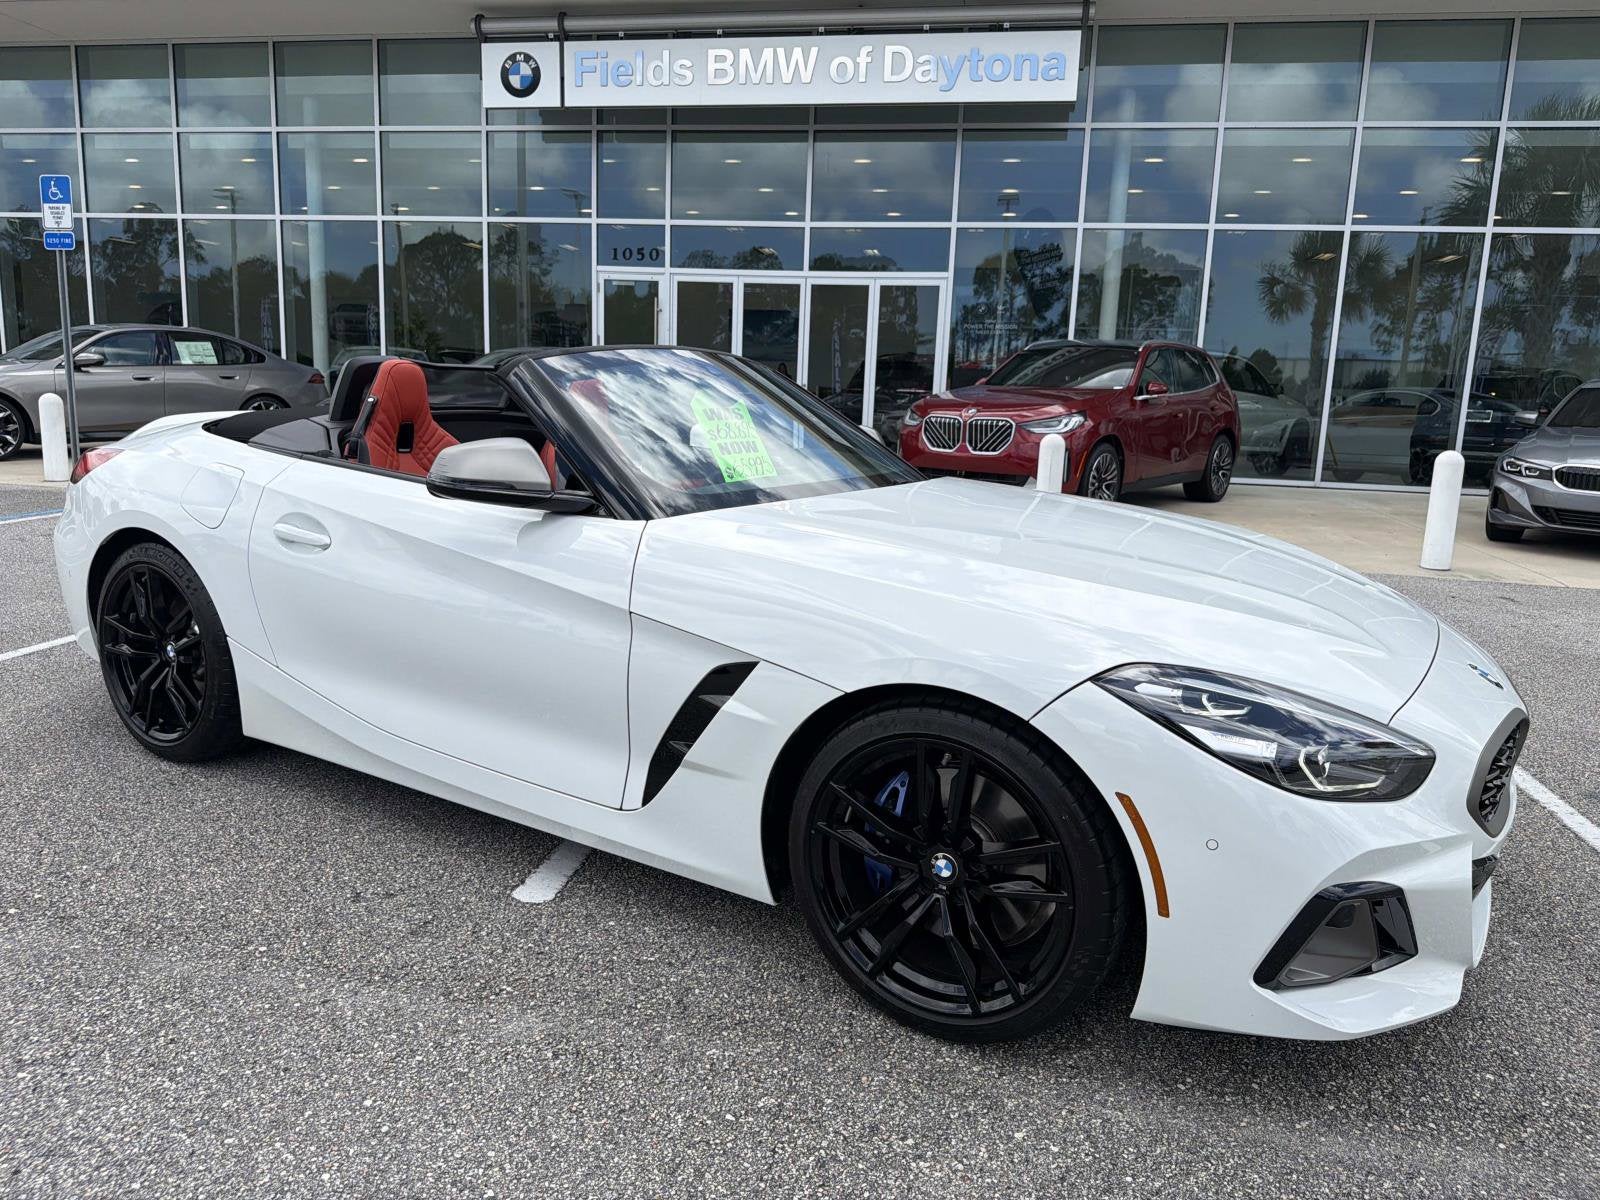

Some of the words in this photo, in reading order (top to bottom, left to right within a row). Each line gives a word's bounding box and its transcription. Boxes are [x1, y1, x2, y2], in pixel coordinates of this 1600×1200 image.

[574, 49, 694, 88] Fields
[706, 46, 819, 86] BMW
[829, 45, 873, 85] of
[882, 44, 1067, 93] Daytona
[612, 246, 660, 261] 1050
[702, 407, 745, 421] WAS
[716, 440, 760, 455] NOW
